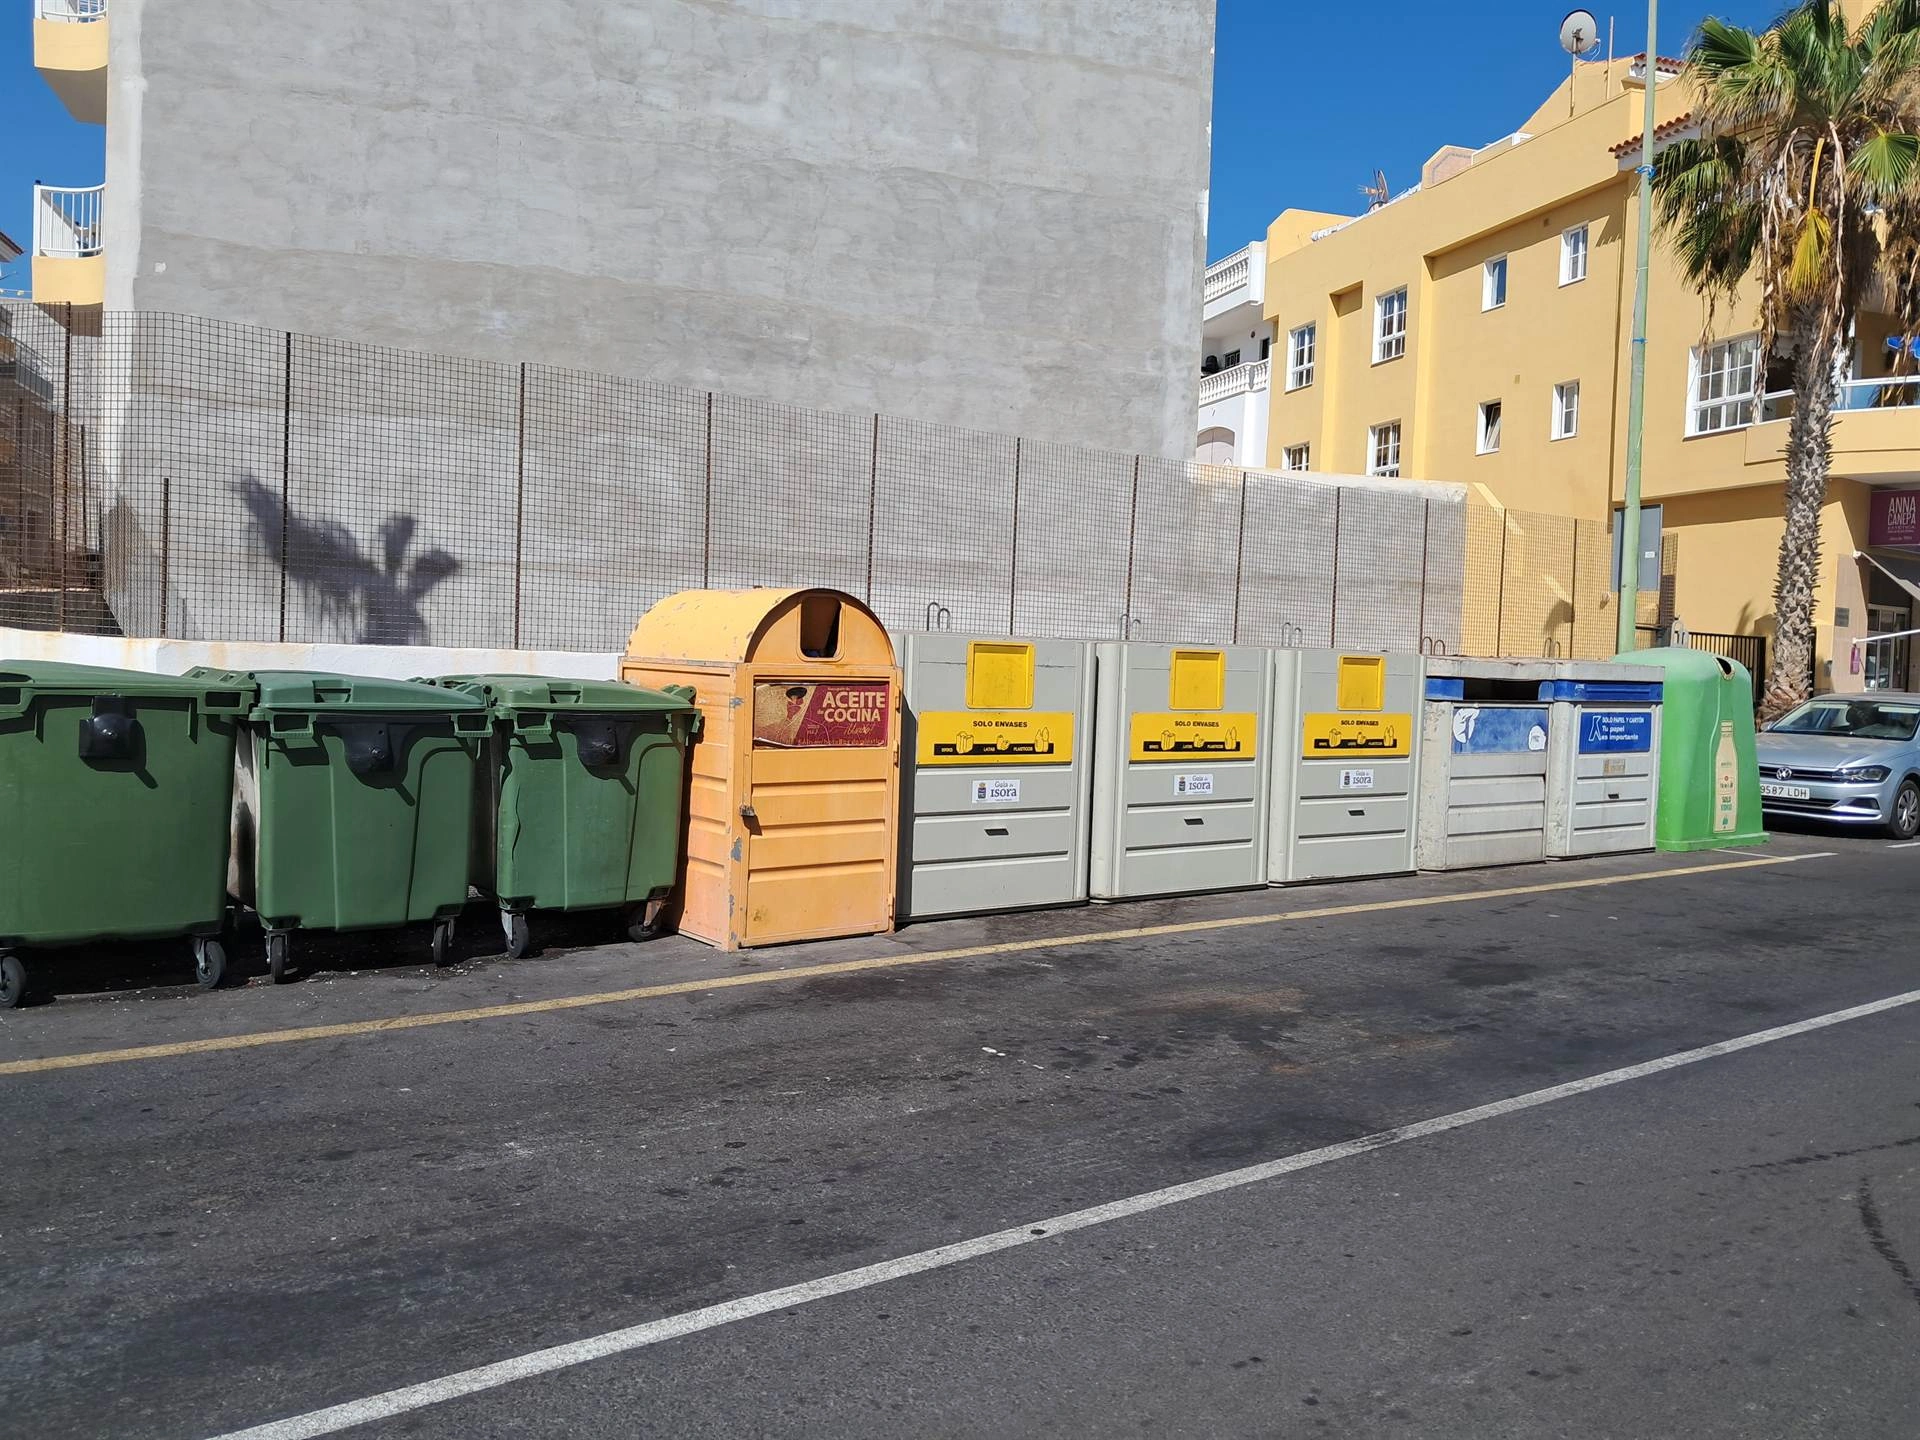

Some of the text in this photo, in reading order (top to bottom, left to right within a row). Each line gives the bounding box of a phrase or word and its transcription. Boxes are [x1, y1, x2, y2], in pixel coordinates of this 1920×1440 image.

[1889, 496, 1916, 513] ANNA
[1888, 512, 1916, 525] CANEPA
[822, 691, 885, 708] ACEITE
[824, 708, 881, 722] COCINA
[995, 720, 1028, 728] ENVASES
[1609, 725, 1625, 733] papel
[1760, 785, 1807, 798] 9587 LDH
